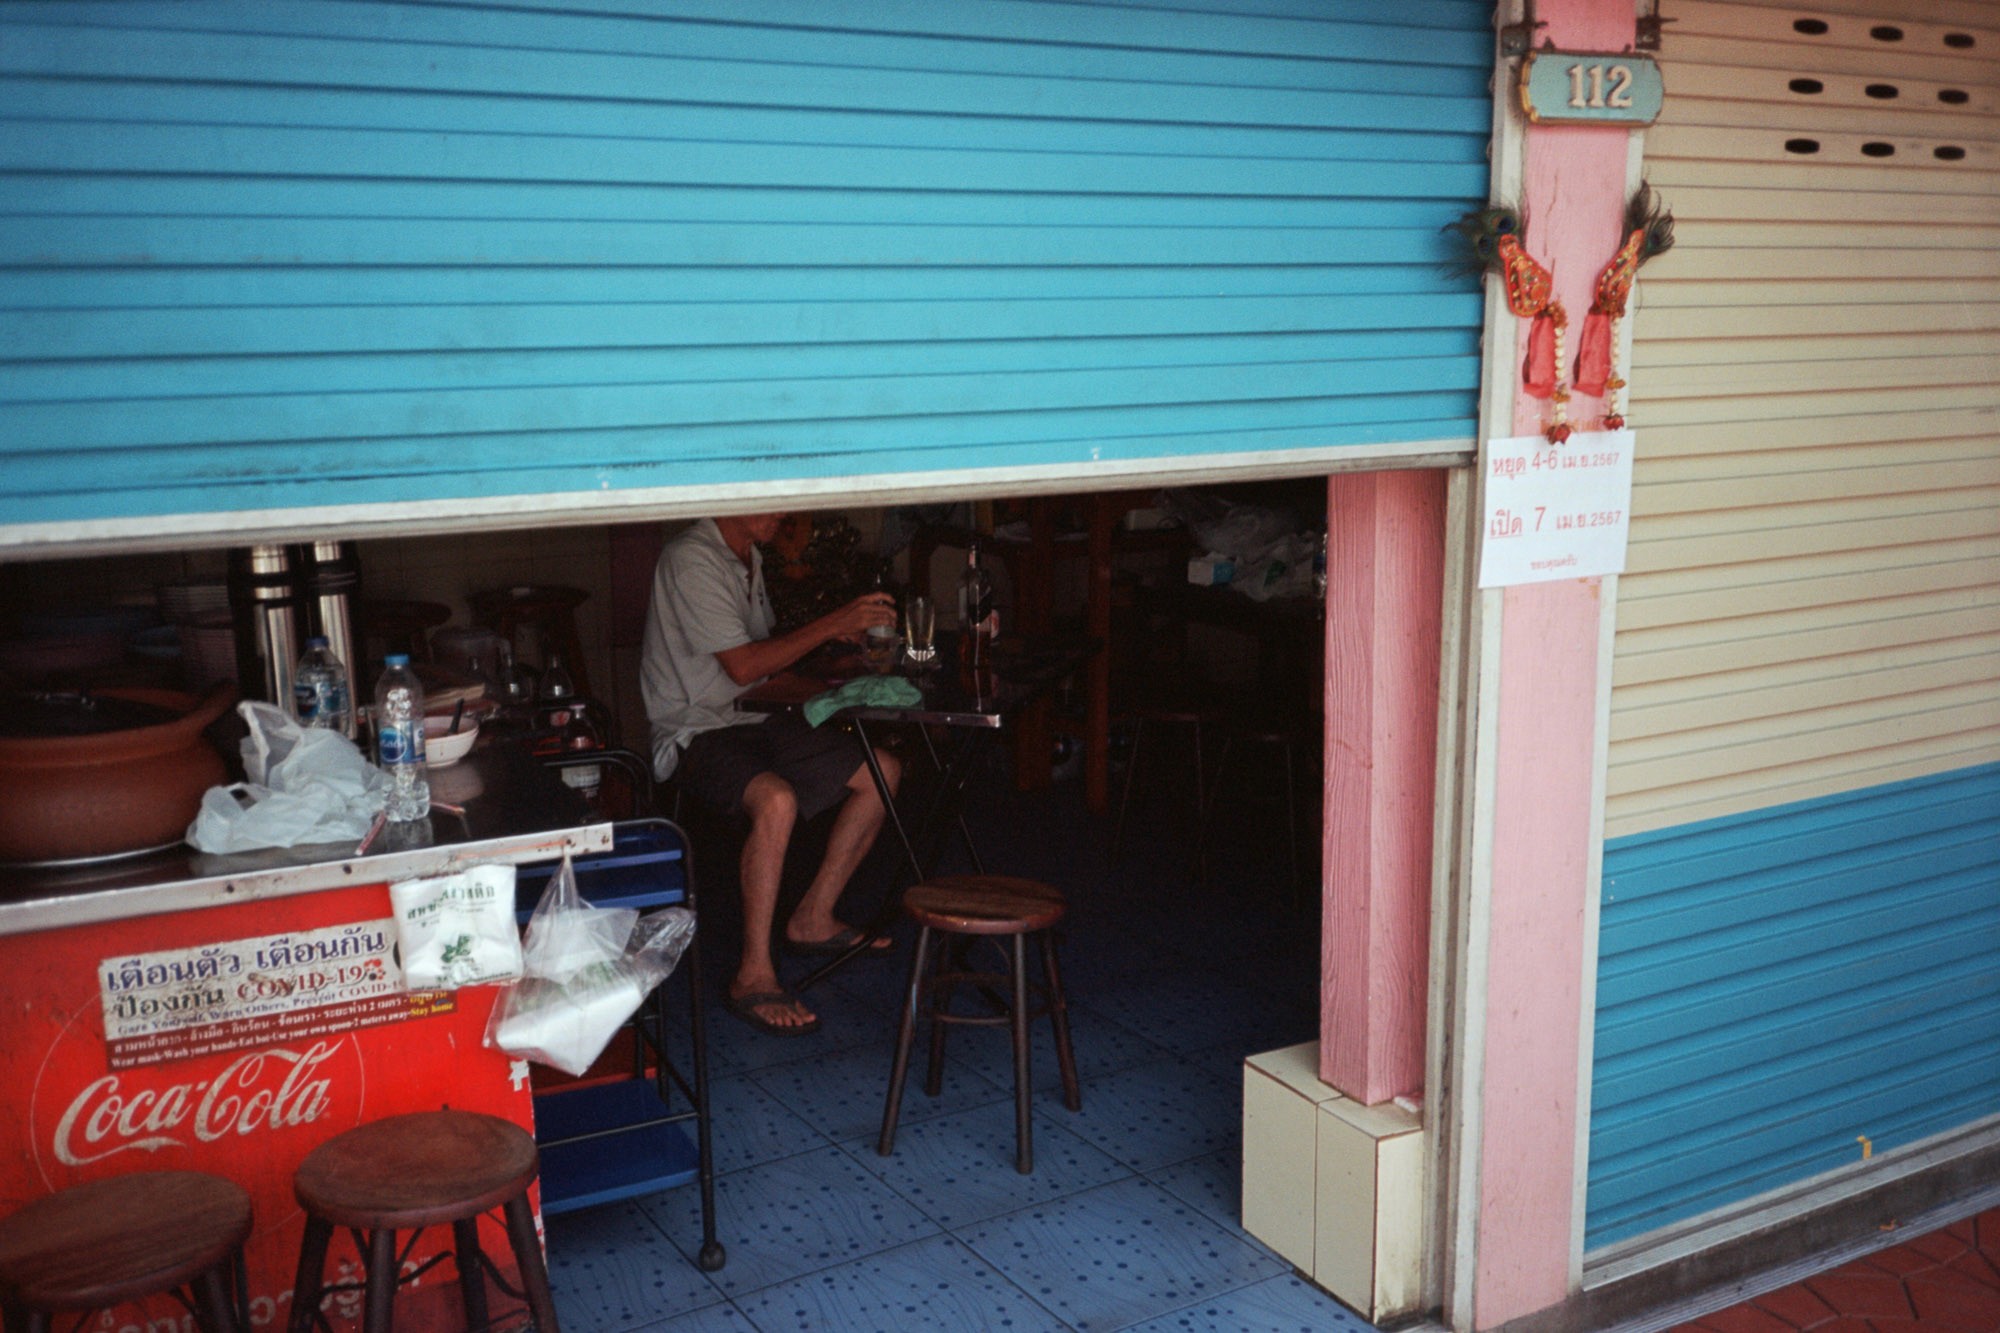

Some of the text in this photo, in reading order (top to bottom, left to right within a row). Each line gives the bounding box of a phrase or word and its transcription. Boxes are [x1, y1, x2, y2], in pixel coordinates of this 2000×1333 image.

[1567, 64, 1633, 109] 112
[1493, 456, 1526, 480] หยุด
[1532, 449, 1558, 470] 4-6
[1490, 508, 1523, 536] เปิด
[1535, 506, 1547, 532] 7
[107, 926, 385, 991] เตือนตัว เตือนกัน
[237, 965, 363, 1003] COVID-19
[54, 1037, 346, 1167] Coca-Cola
